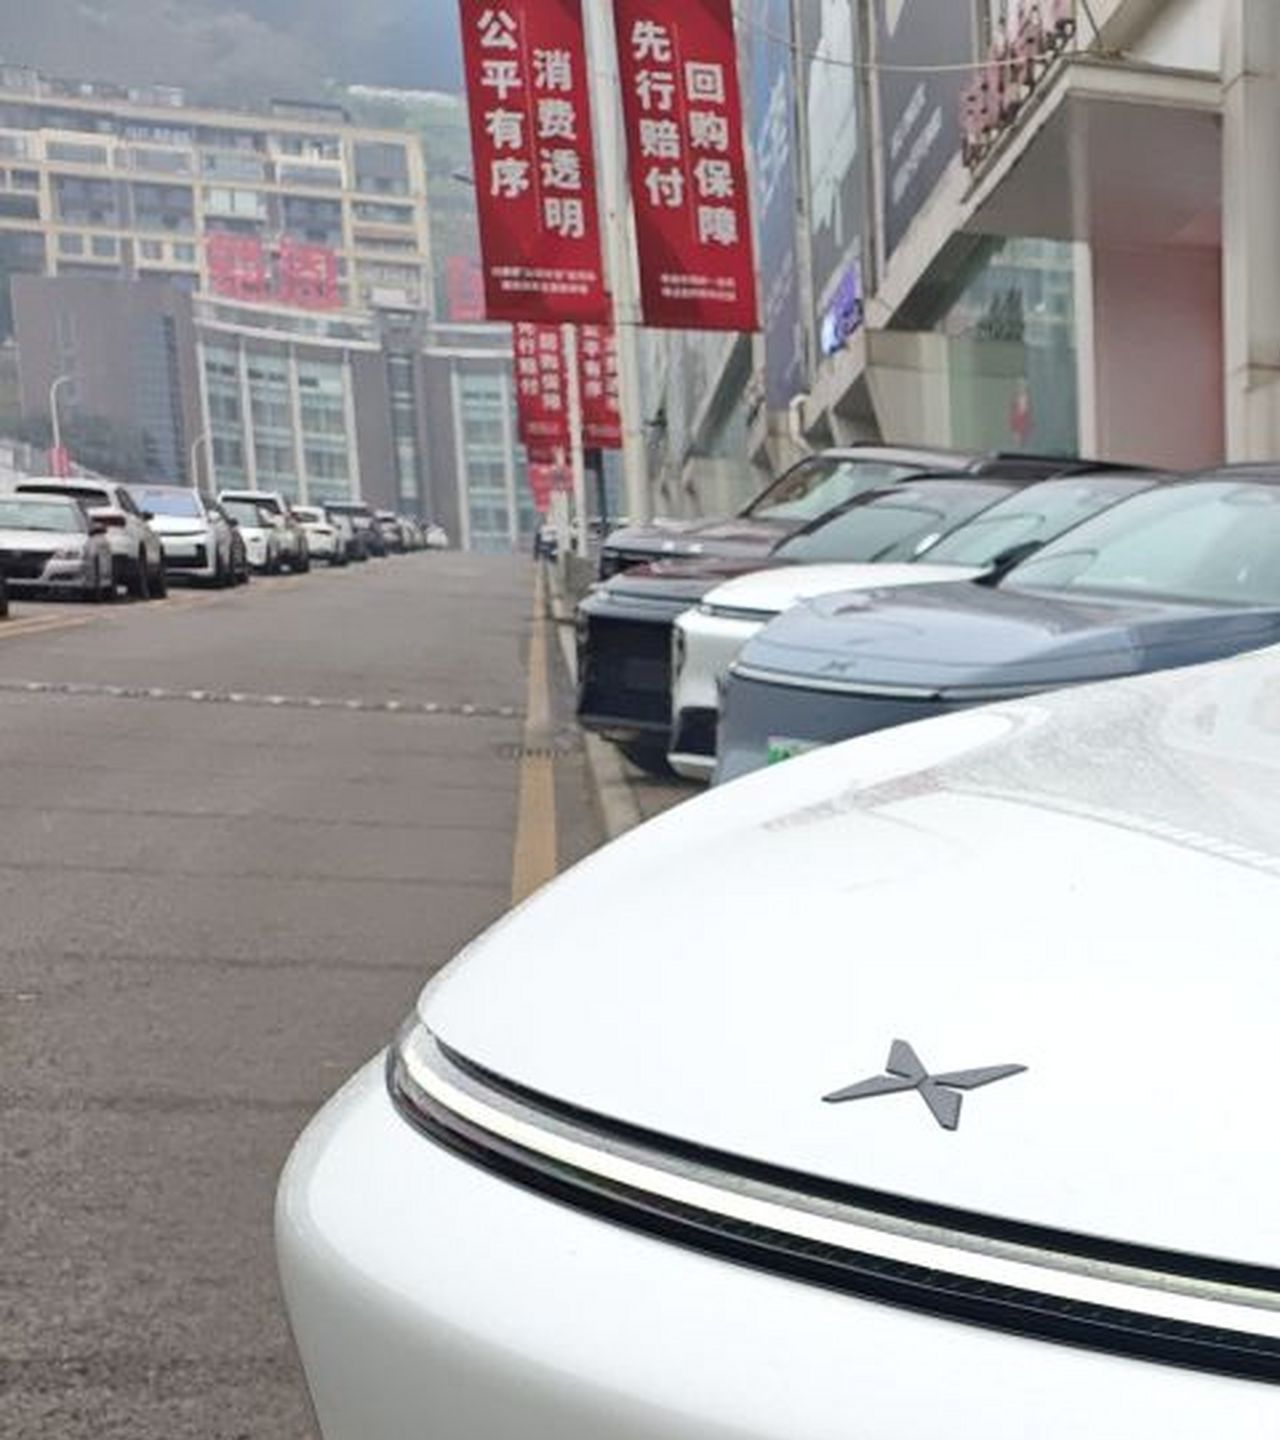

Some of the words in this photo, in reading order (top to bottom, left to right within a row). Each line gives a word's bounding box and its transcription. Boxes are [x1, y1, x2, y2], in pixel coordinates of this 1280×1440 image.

[476, 9, 530, 199] 公平有序
[533, 48, 585, 239] 消费透明
[631, 20, 685, 208] 先行赔付
[684, 61, 739, 247] 回购保障
